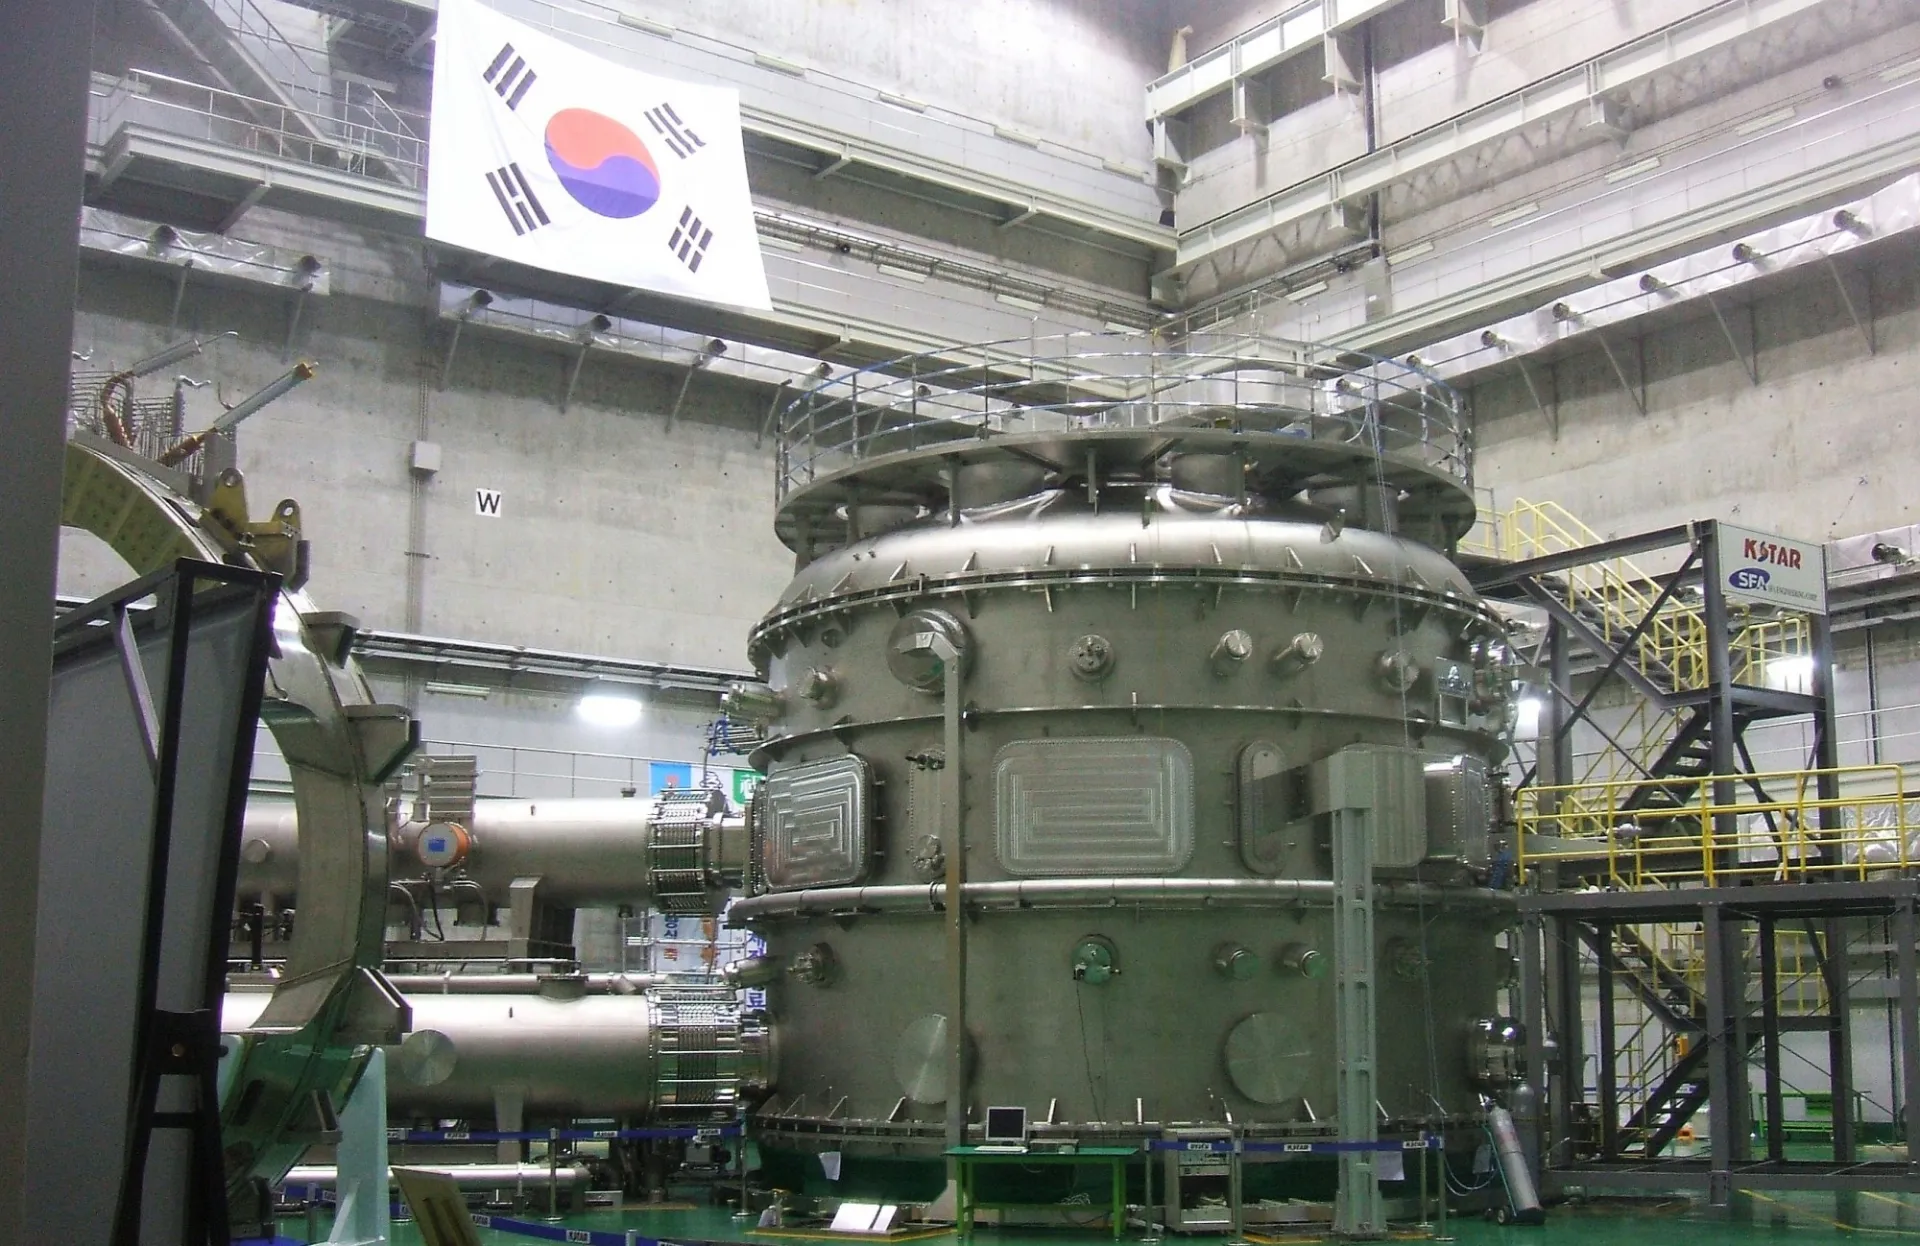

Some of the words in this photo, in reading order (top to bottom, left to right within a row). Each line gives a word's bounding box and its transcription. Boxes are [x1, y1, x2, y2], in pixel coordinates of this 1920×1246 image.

[477, 491, 501, 514] W
[1744, 538, 1801, 570] KSTAR
[1738, 571, 1767, 591] SFA
